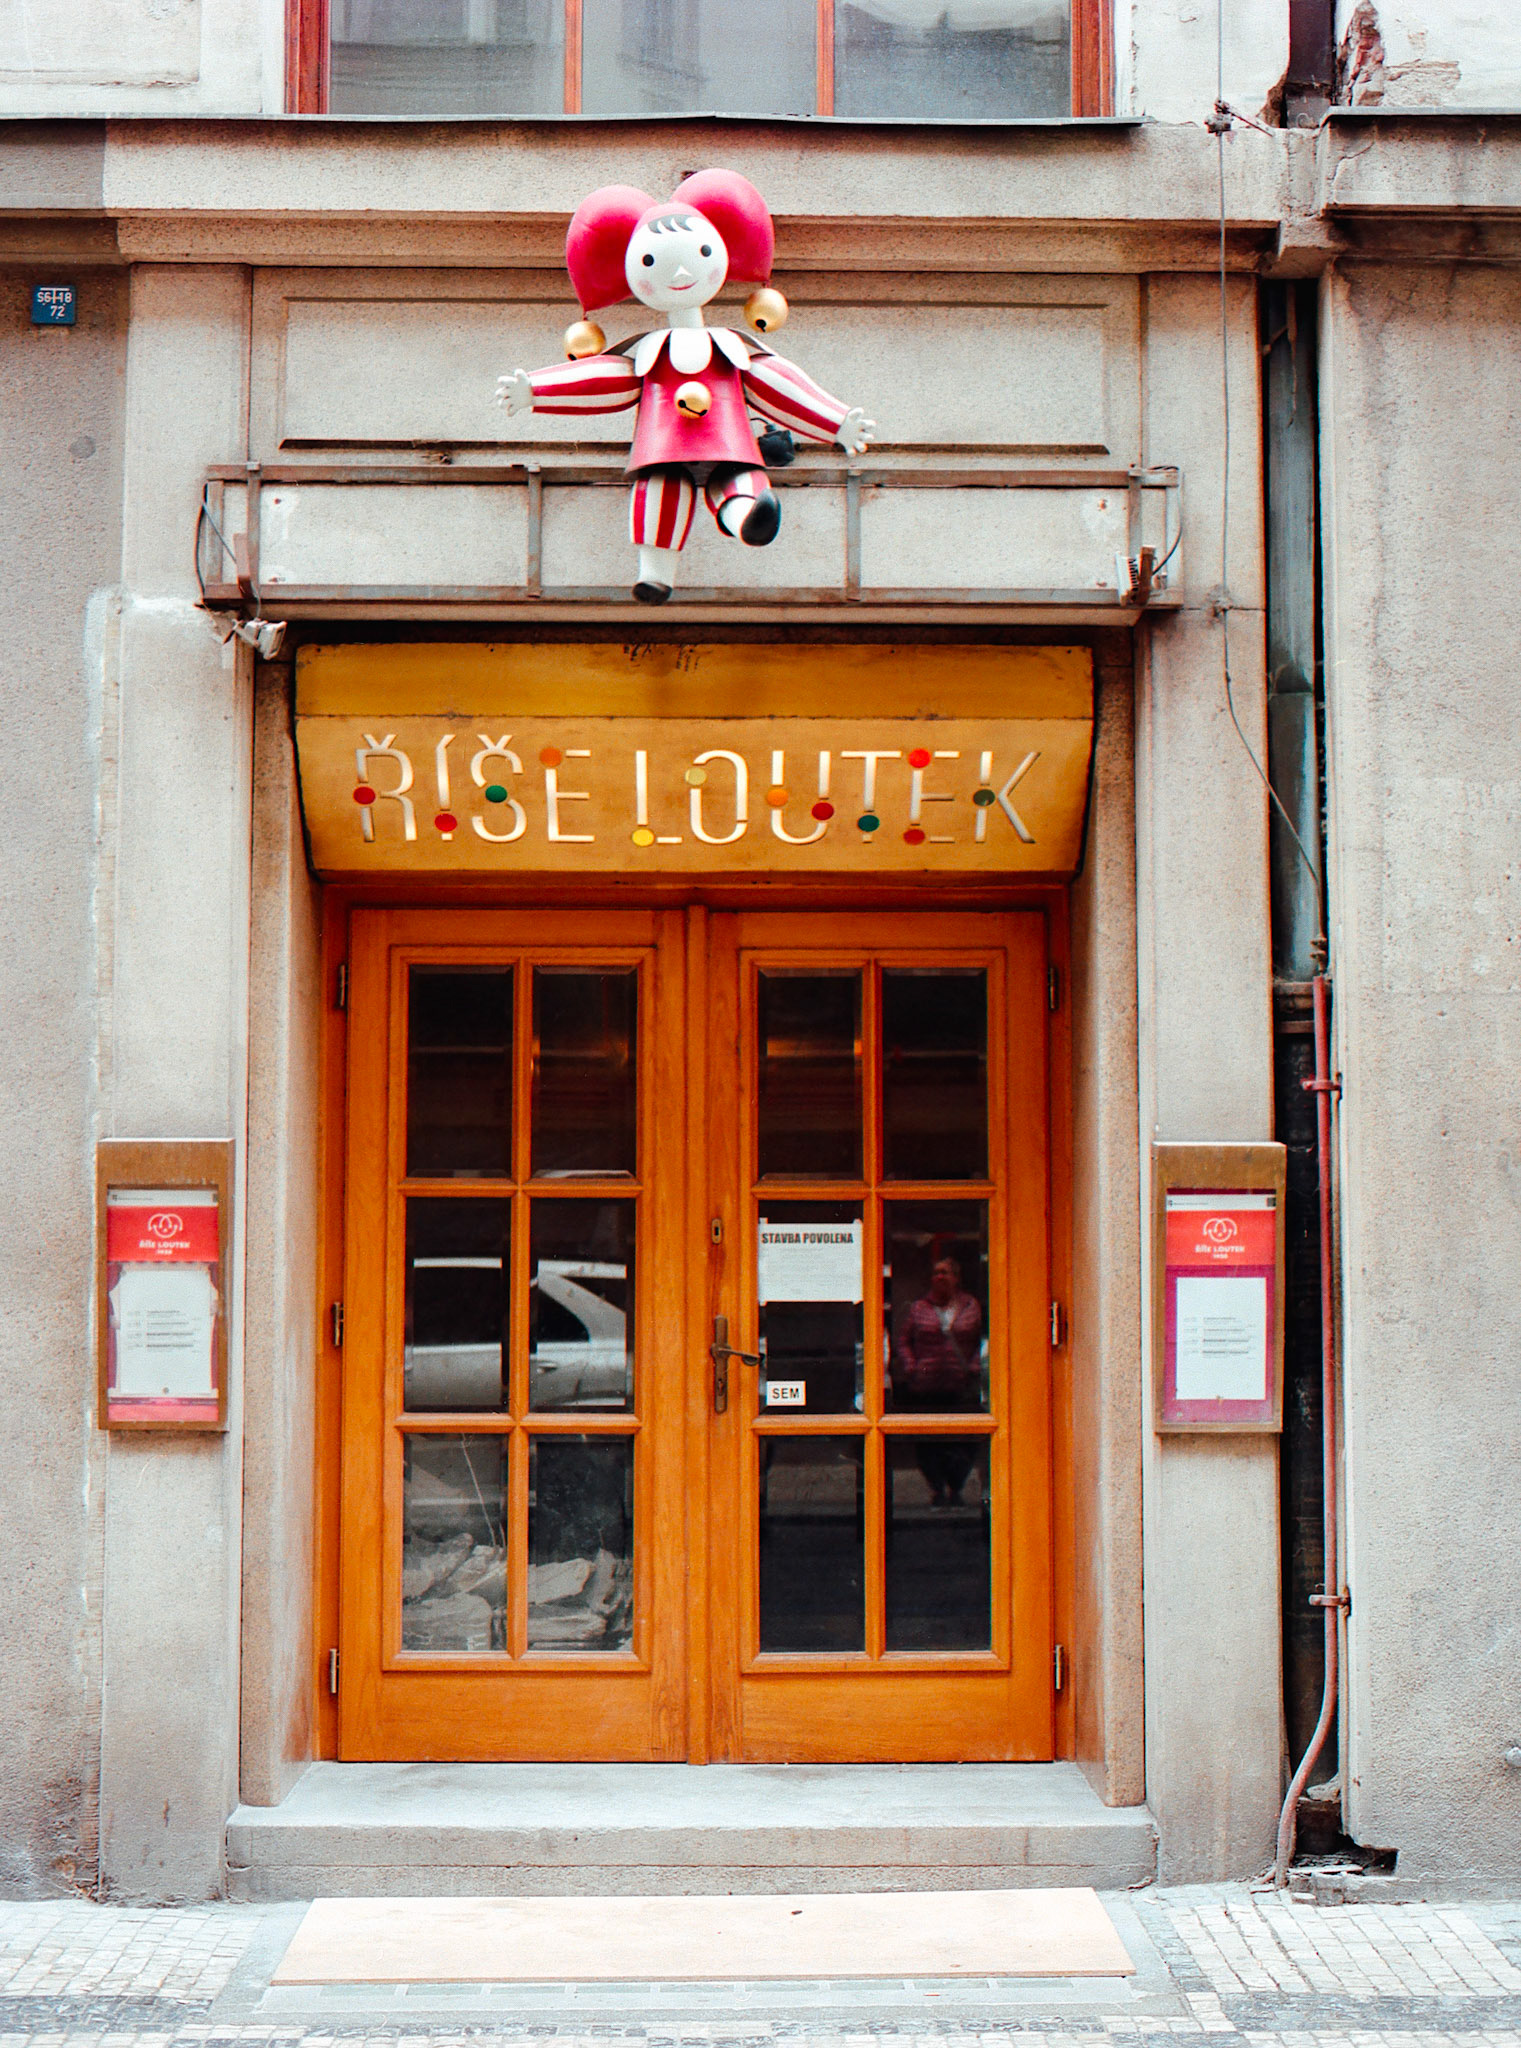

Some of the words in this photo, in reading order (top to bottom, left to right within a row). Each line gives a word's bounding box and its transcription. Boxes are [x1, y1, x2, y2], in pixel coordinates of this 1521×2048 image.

[353, 733, 595, 843] ŘÍŠE
[634, 749, 1042, 845] LOUTEK
[761, 1232, 800, 1244] STAVBA
[802, 1232, 854, 1244] POVOLENA
[772, 1387, 800, 1399] SEM
